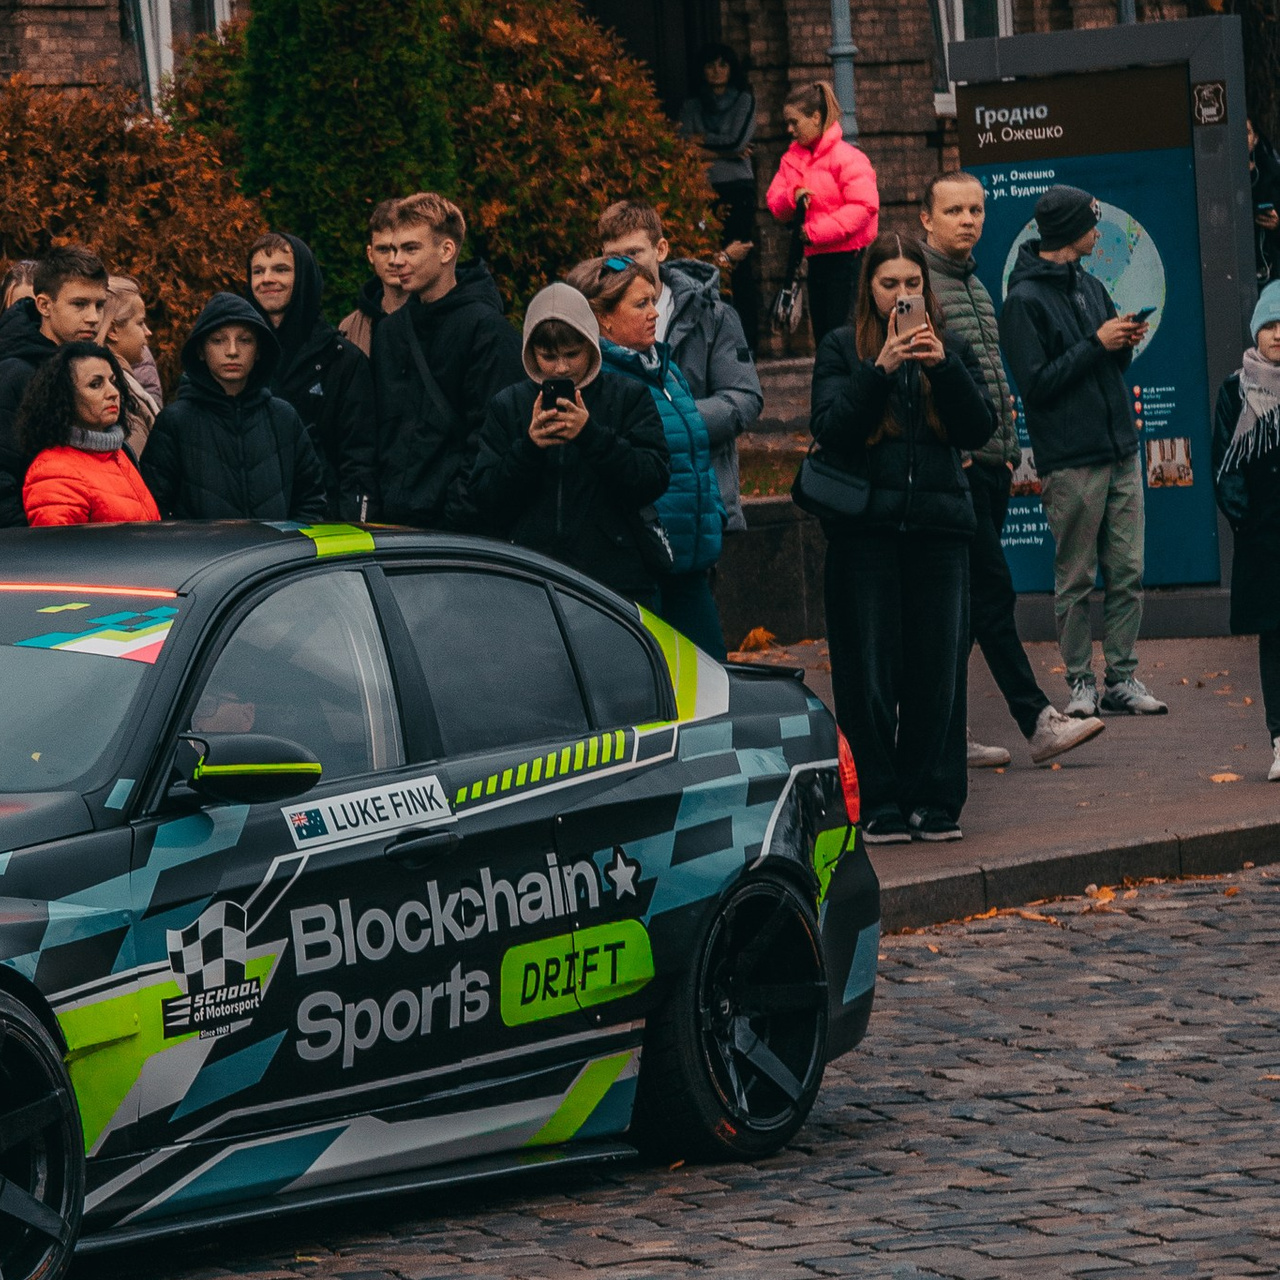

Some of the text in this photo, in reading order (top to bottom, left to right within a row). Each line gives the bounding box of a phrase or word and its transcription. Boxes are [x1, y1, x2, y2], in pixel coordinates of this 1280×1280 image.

[975, 105, 1048, 129] Гродно
[978, 125, 1064, 148] ул. Ожешко
[992, 169, 1055, 185] ул. Ожешко
[993, 185, 1050, 200] ул. Буденн
[1007, 506, 1030, 516] тель
[328, 784, 443, 832] LUKE FINK
[289, 851, 600, 976] Blockchain
[193, 981, 260, 1008] SCHOOL
[296, 940, 627, 1069] Sports DRIFT
[193, 996, 260, 1022] of Motorsport
[200, 1028, 216, 1038] Since
